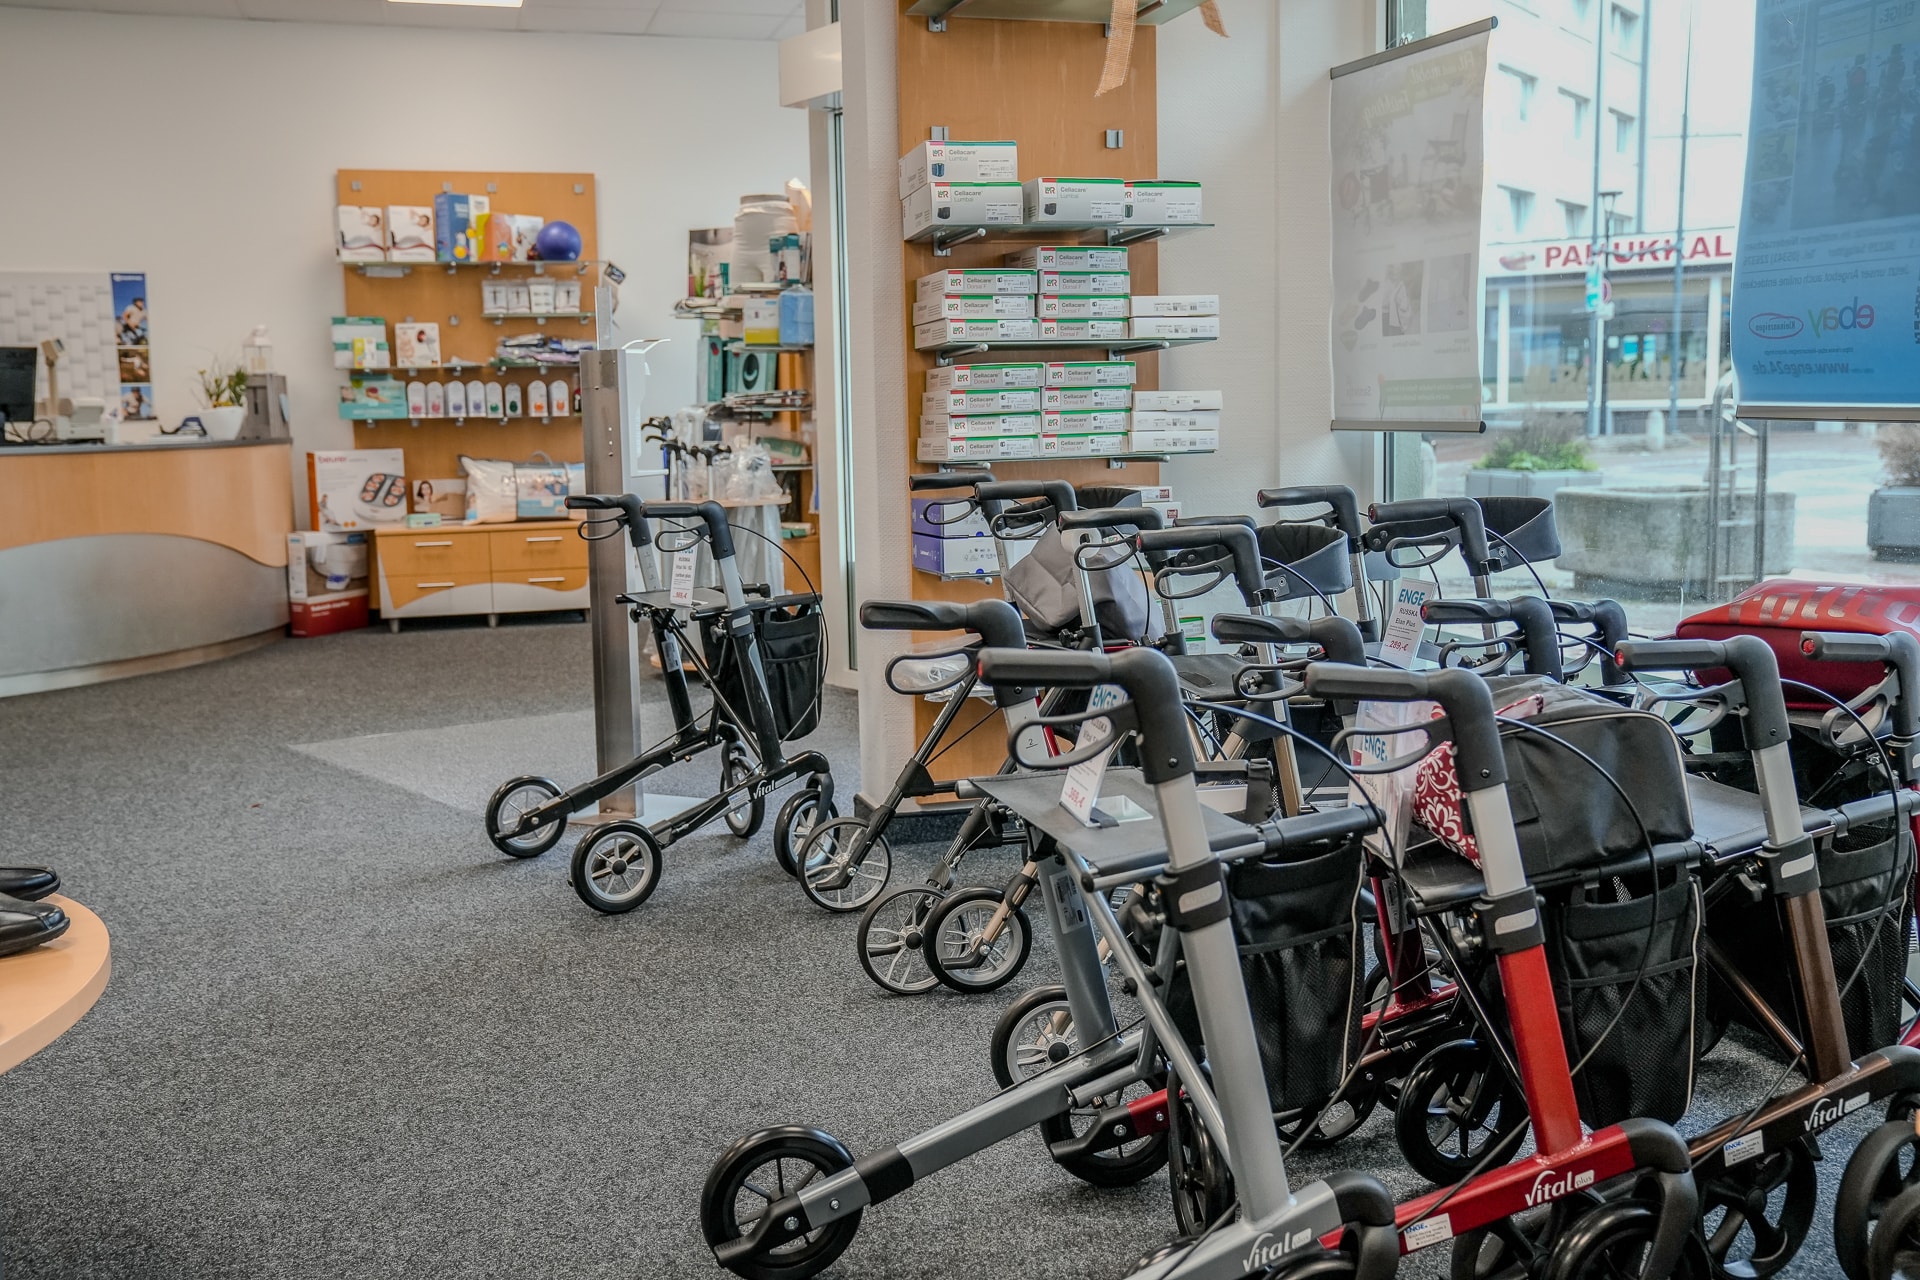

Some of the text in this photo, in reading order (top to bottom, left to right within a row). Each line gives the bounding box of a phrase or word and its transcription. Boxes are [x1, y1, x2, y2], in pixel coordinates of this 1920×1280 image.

[1546, 235, 1732, 268] PAUKKAL
[1399, 588, 1425, 606] ENGE
[1399, 608, 1418, 617] RUSSKA
[1395, 618, 1416, 627] Elan Plus
